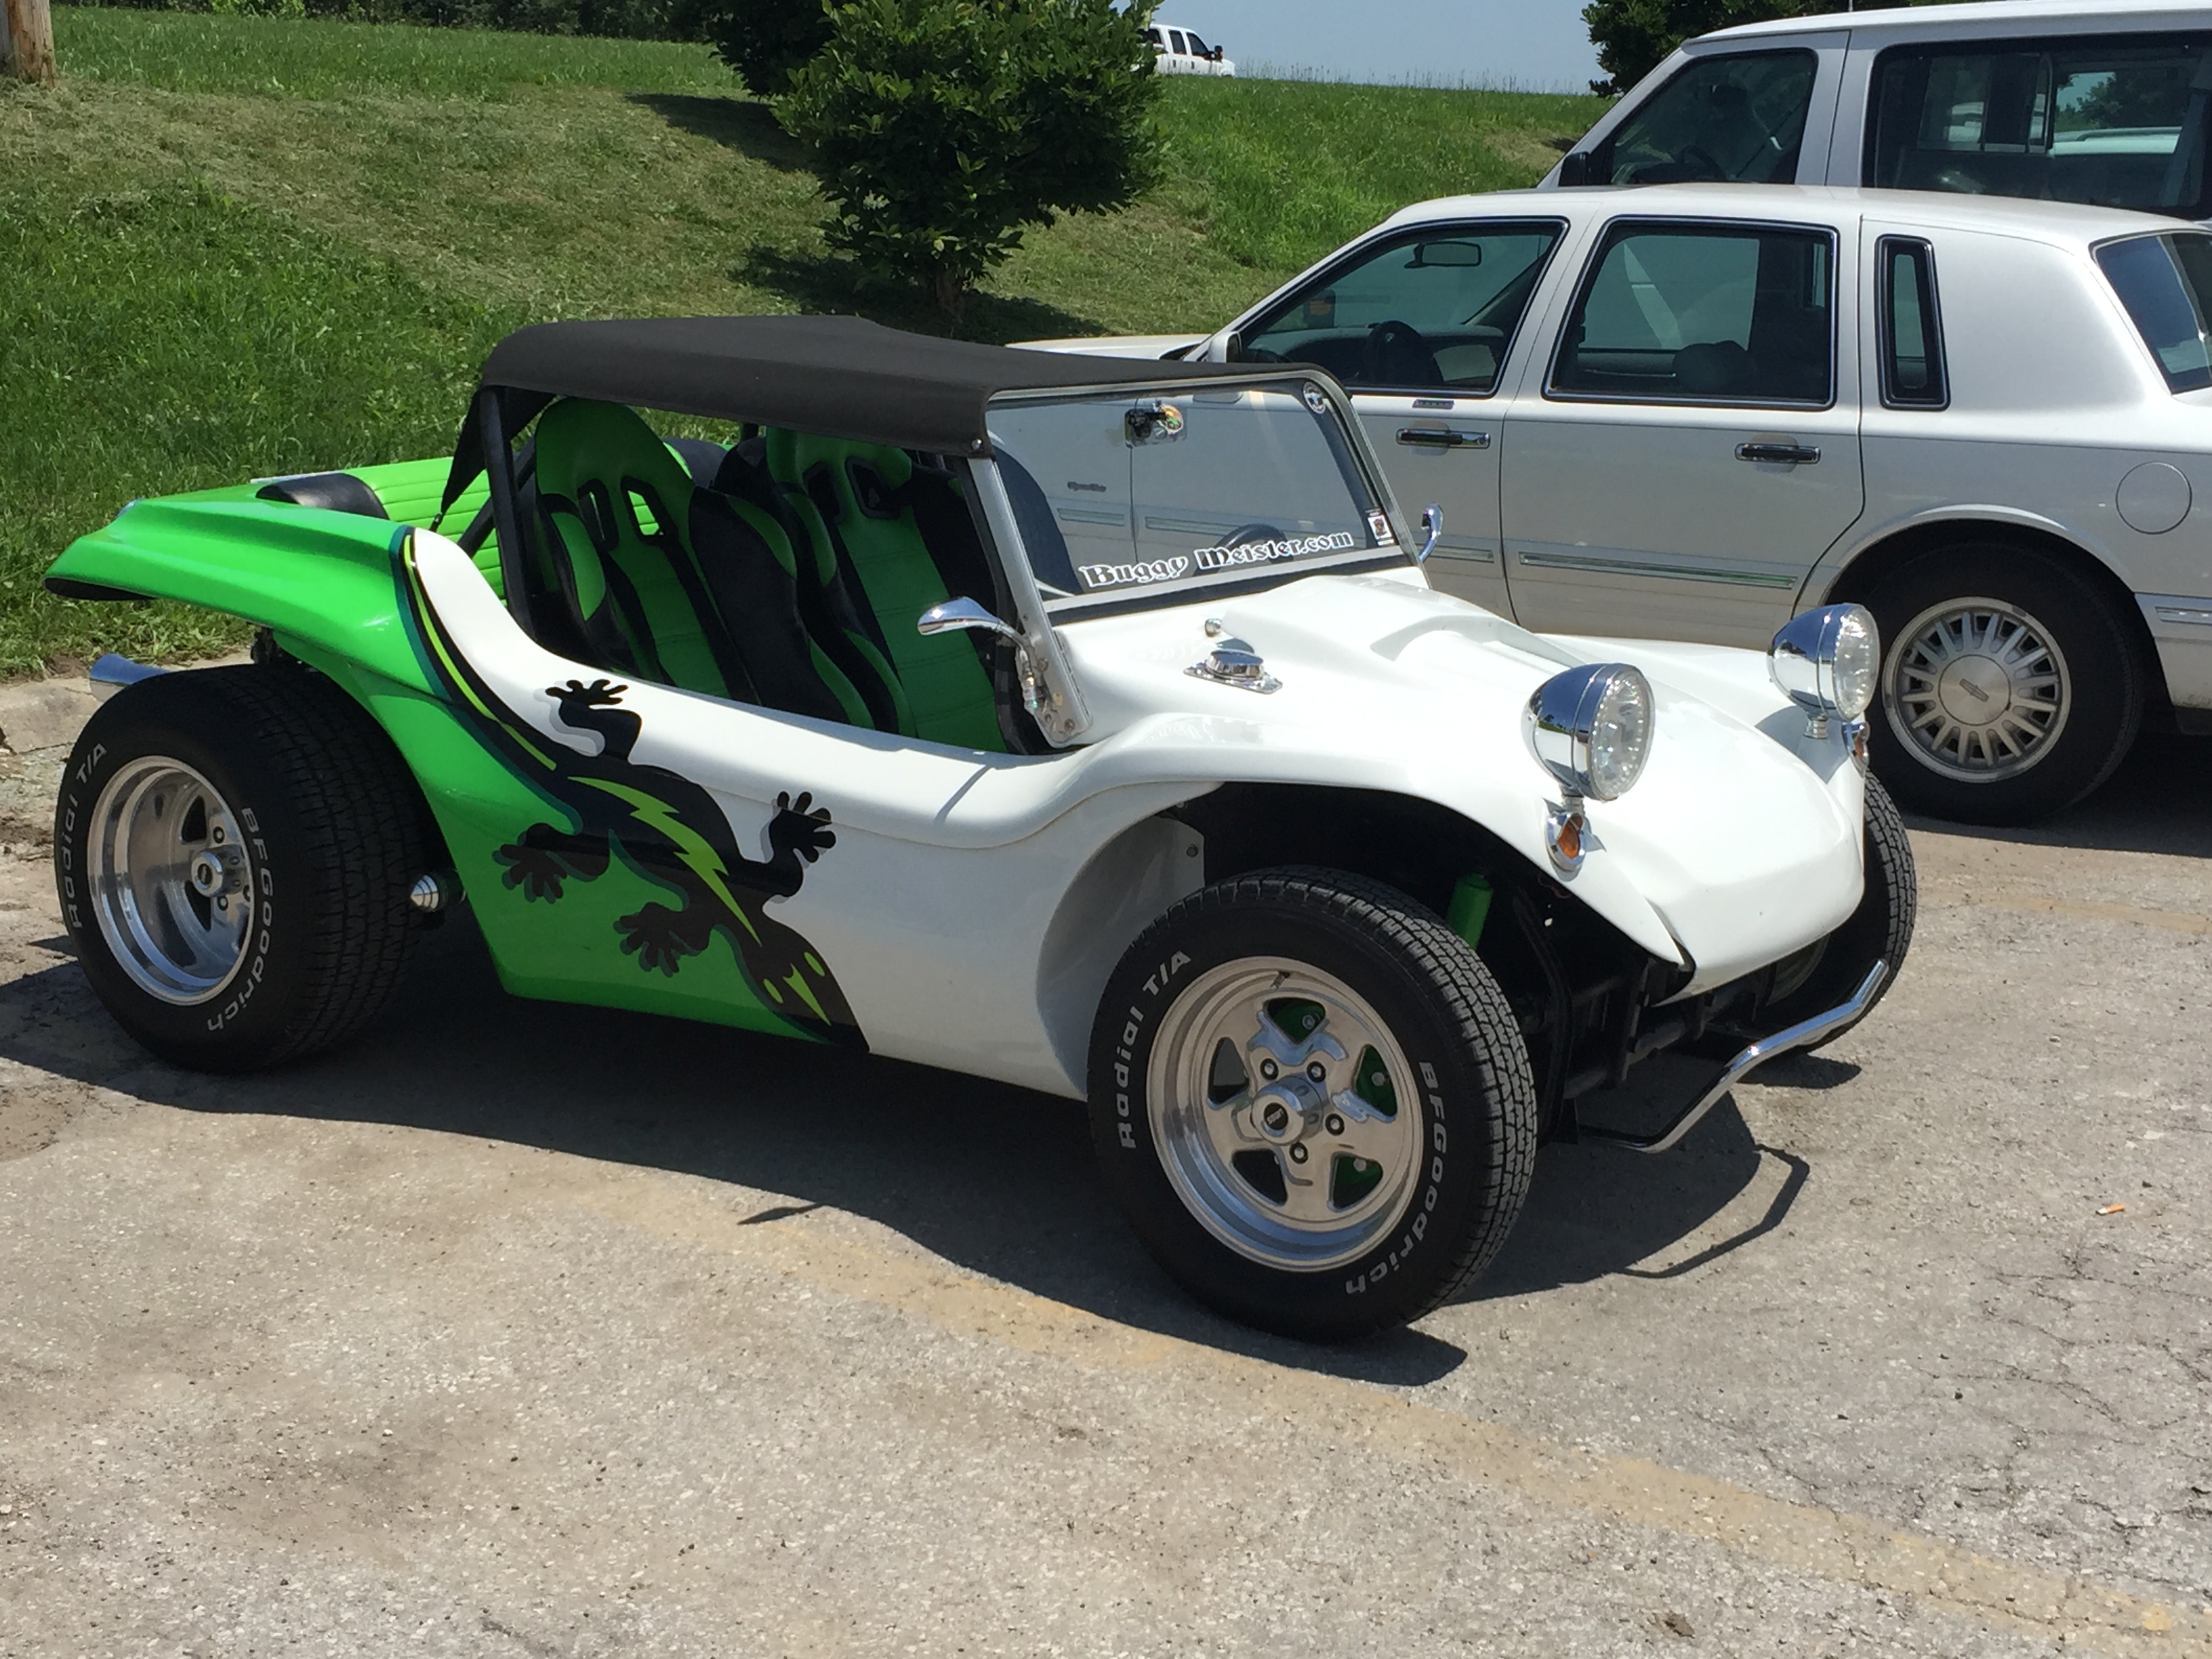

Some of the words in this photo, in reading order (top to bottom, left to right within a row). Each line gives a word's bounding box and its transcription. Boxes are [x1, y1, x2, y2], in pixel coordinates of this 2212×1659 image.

[1079, 556, 1189, 588] Buggy
[1193, 532, 1354, 570] Meister.com
[61, 794, 83, 929] Radial
[75, 743, 108, 784] T/A
[1114, 1006, 1144, 1149] Radial
[1142, 950, 1192, 997] T/A
